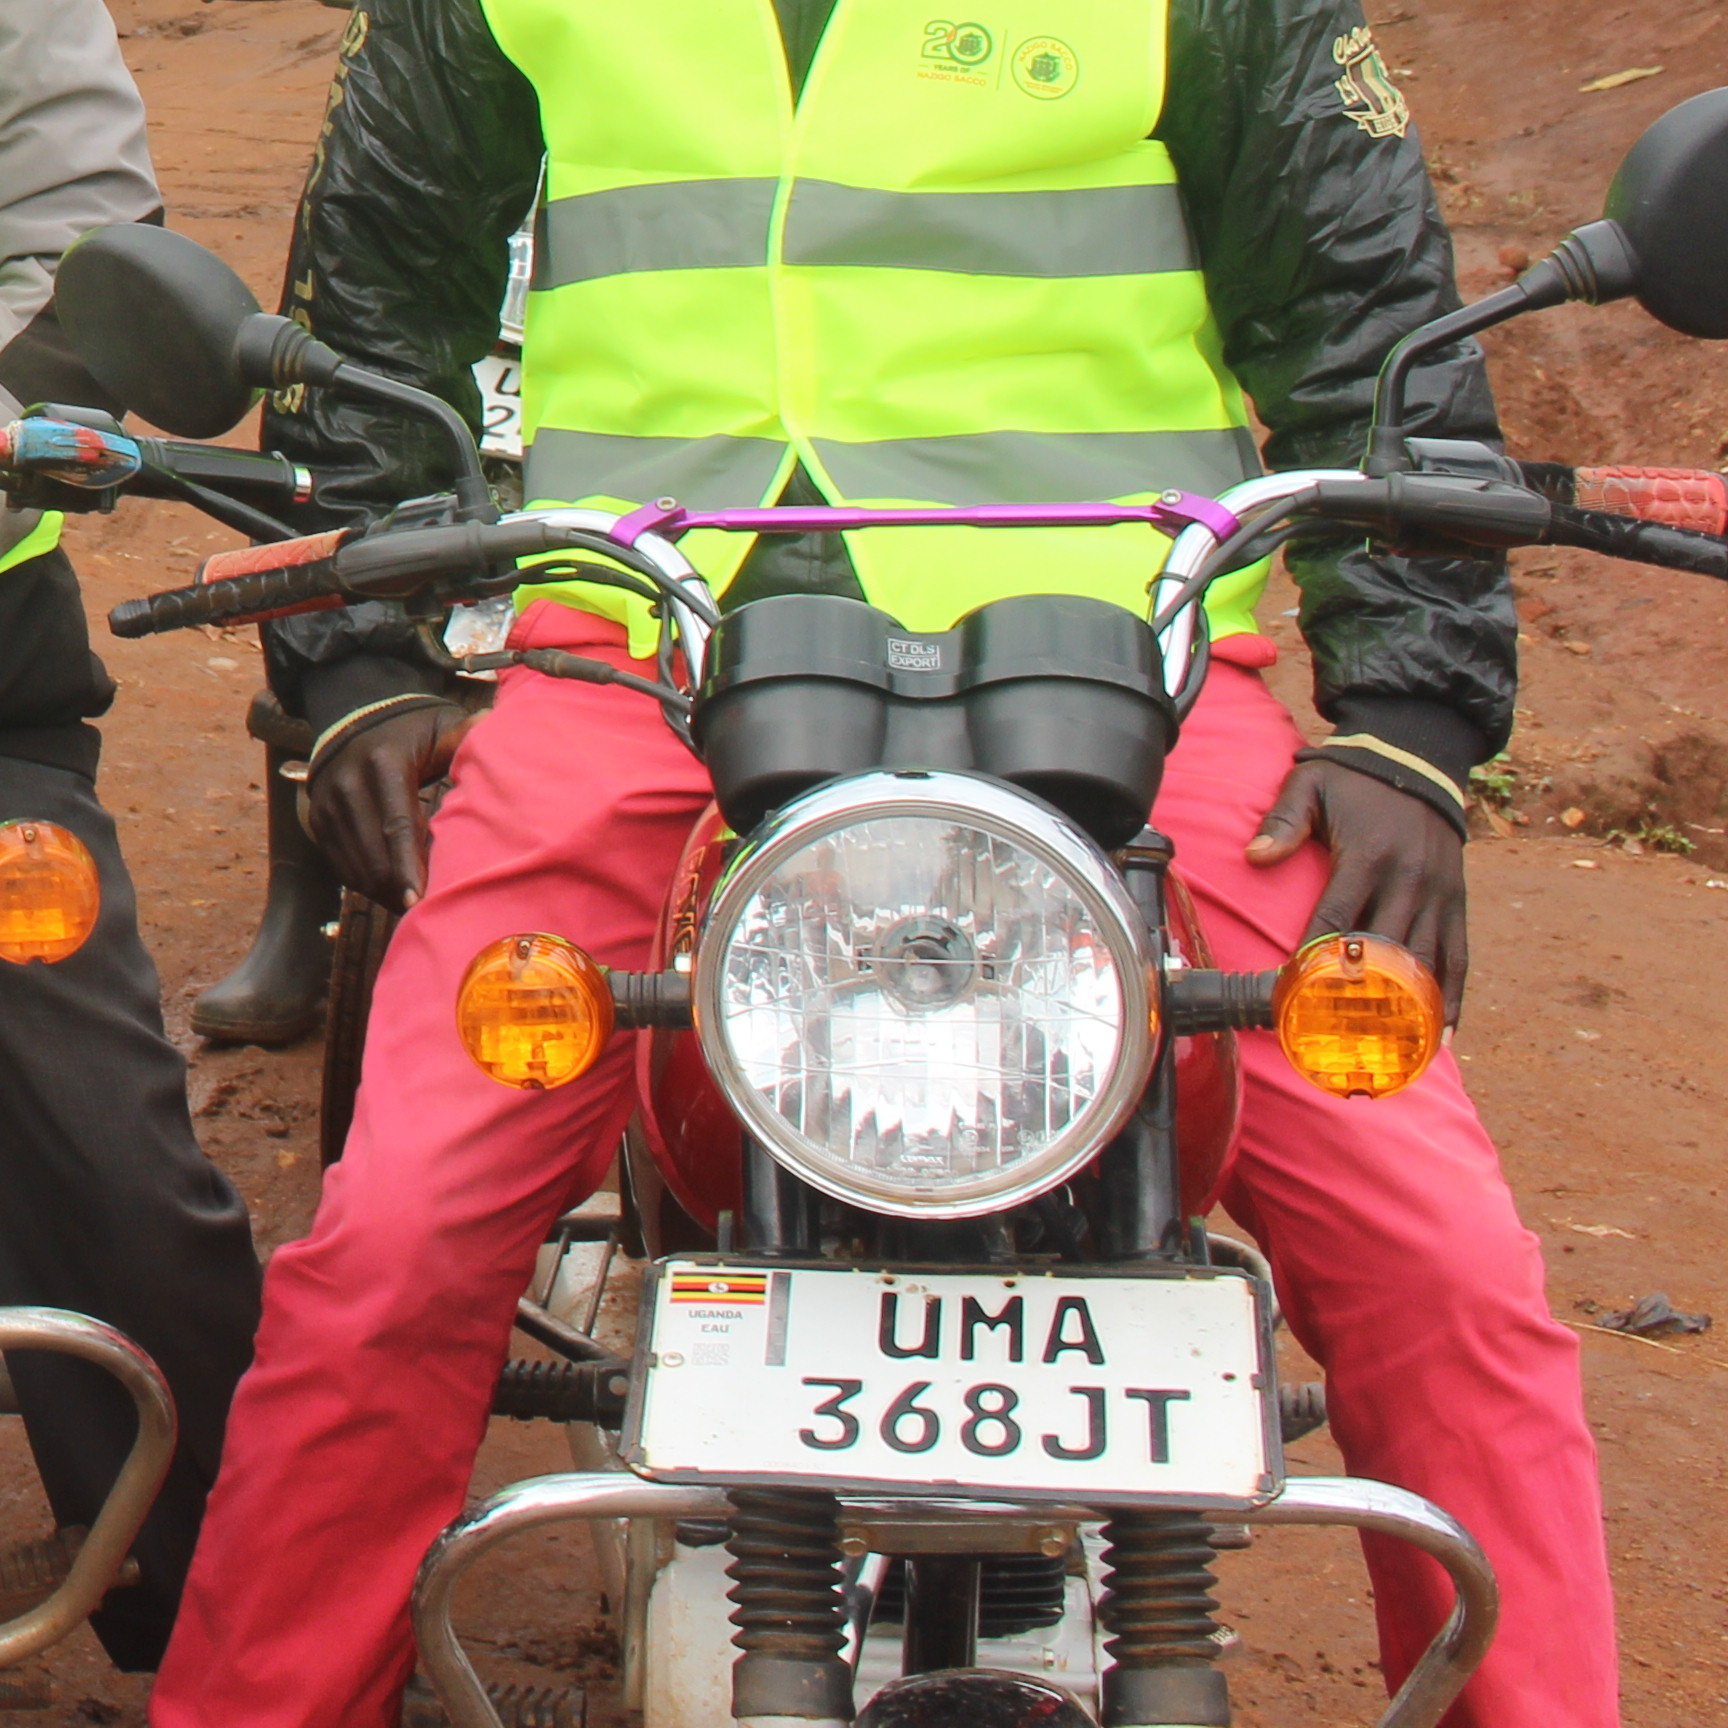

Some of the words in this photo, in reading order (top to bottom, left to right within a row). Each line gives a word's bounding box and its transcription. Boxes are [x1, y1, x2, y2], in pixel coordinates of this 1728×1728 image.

[920, 19, 993, 66] 20
[1018, 40, 1048, 63] NAZIGO
[1049, 42, 1073, 71] SACCO
[933, 63, 958, 73] YEARS
[959, 66, 971, 74] OF
[916, 70, 952, 82] NAZIGO
[954, 74, 987, 87] SACCO
[891, 642, 908, 653] CT
[910, 644, 935, 655] DLS
[891, 654, 937, 668] EXPORT
[688, 1309, 743, 1320] UGANDA
[701, 1323, 730, 1334] EAU
[878, 1291, 1105, 1366] UMA
[798, 1376, 1192, 1465] 368JT
